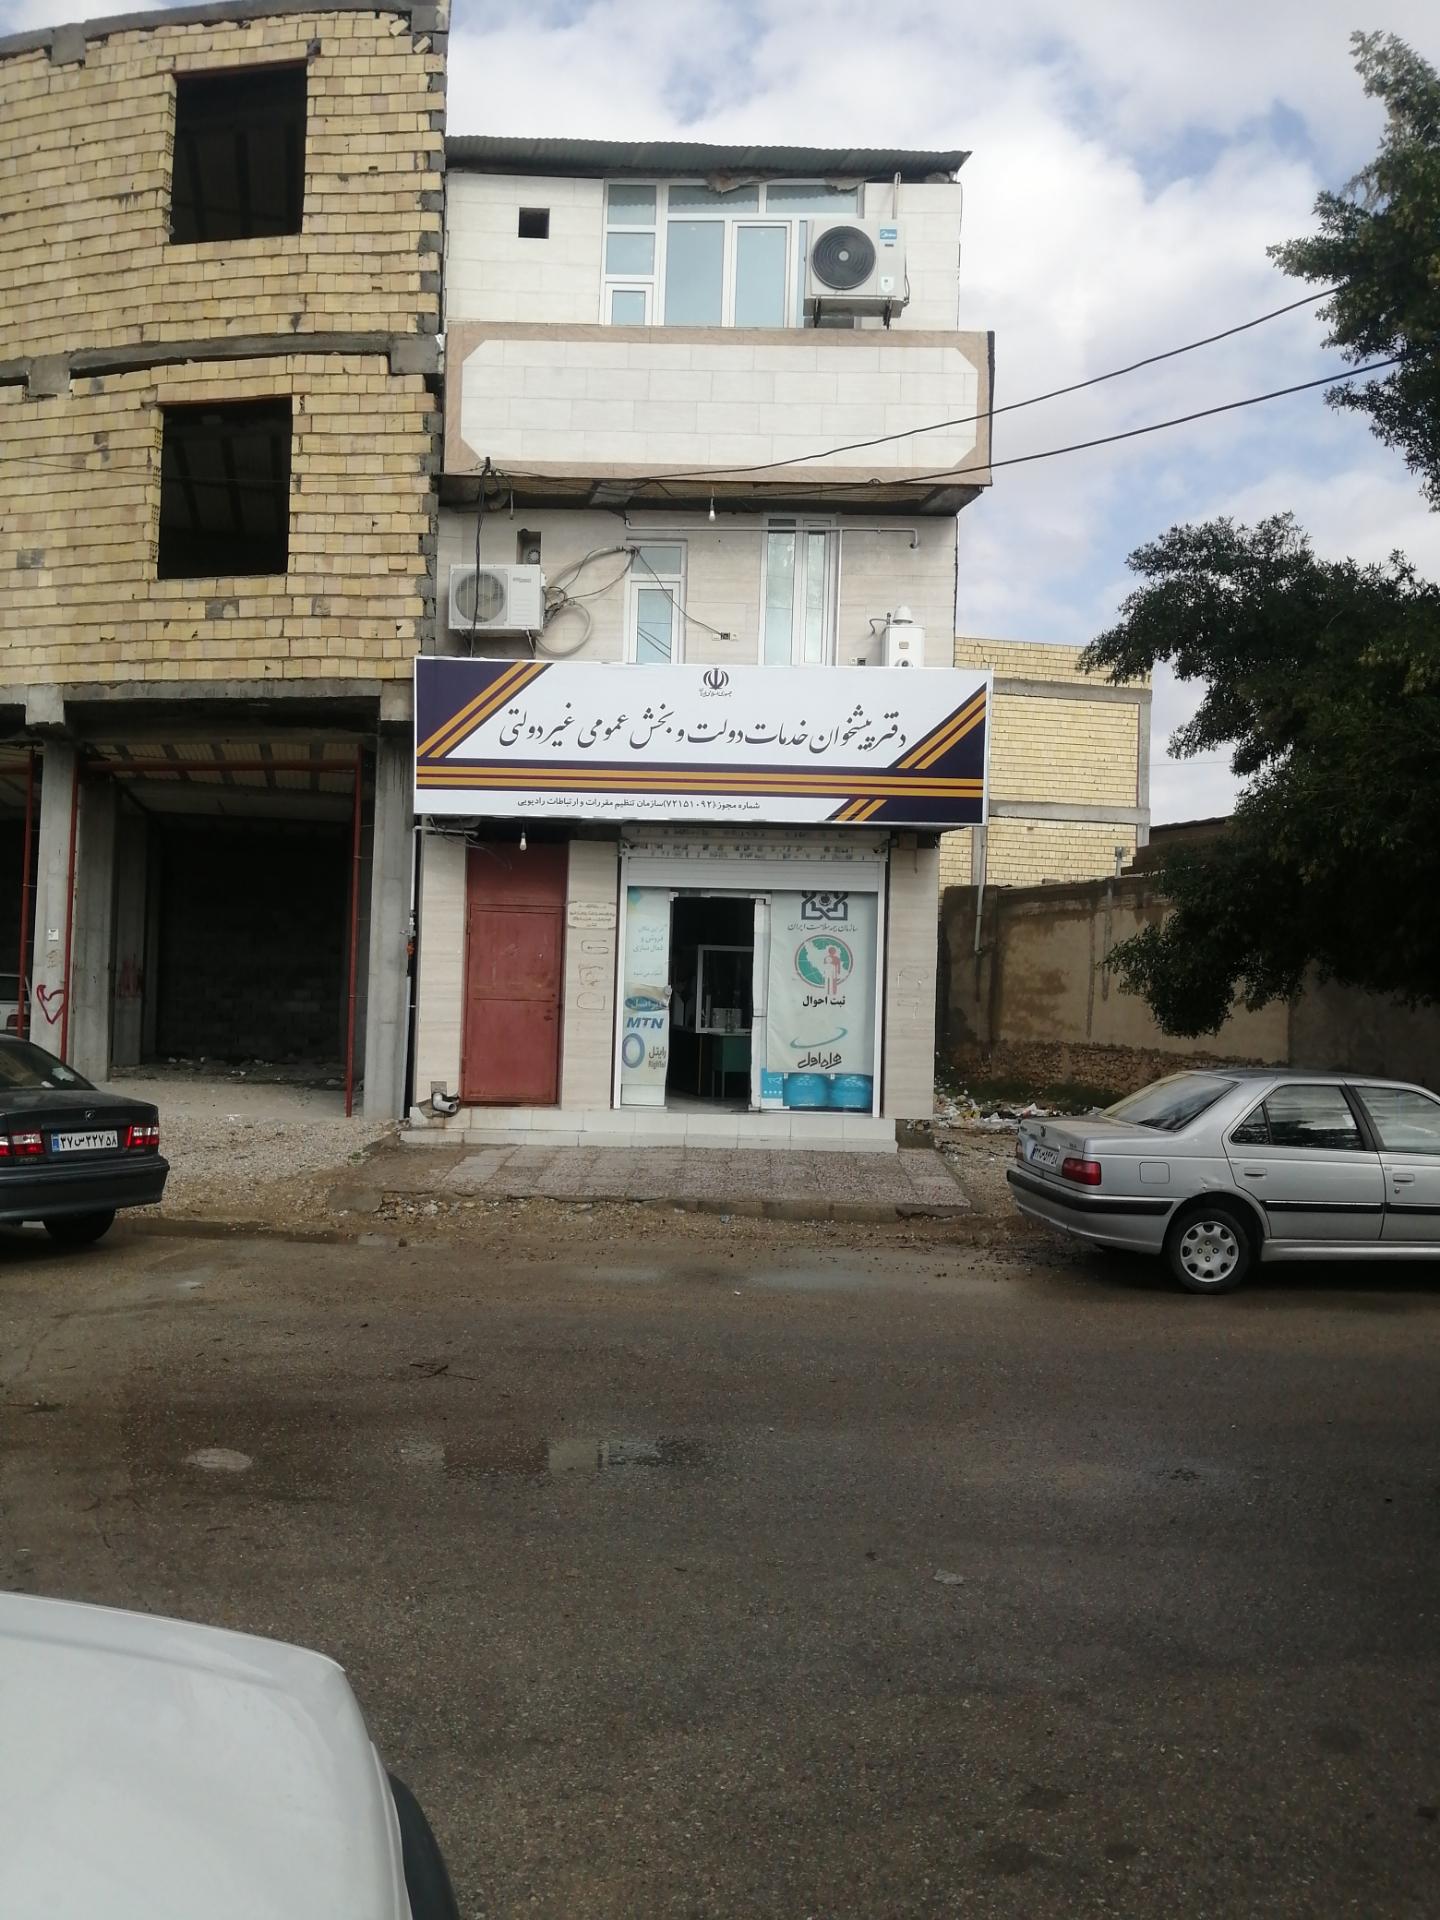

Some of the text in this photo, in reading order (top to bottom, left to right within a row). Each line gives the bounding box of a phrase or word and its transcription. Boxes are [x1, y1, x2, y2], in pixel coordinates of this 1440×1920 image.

[499, 702, 906, 754] دفتر پیشخوان خدمات دولت و بخش عمومی غیر دولتی
[517, 797, 546, 806] رادیویی
[546, 797, 579, 807] ارتباطات
[579, 798, 585, 807] و
[585, 799, 613, 808] مقررات
[614, 799, 635, 810] تنظیم
[717, 801, 737, 811] مجوز
[738, 801, 761, 811] شماره
[803, 995, 846, 1008] ثبت احوال
[626, 1017, 664, 1029] MTN
[648, 1046, 667, 1059] رایتل
